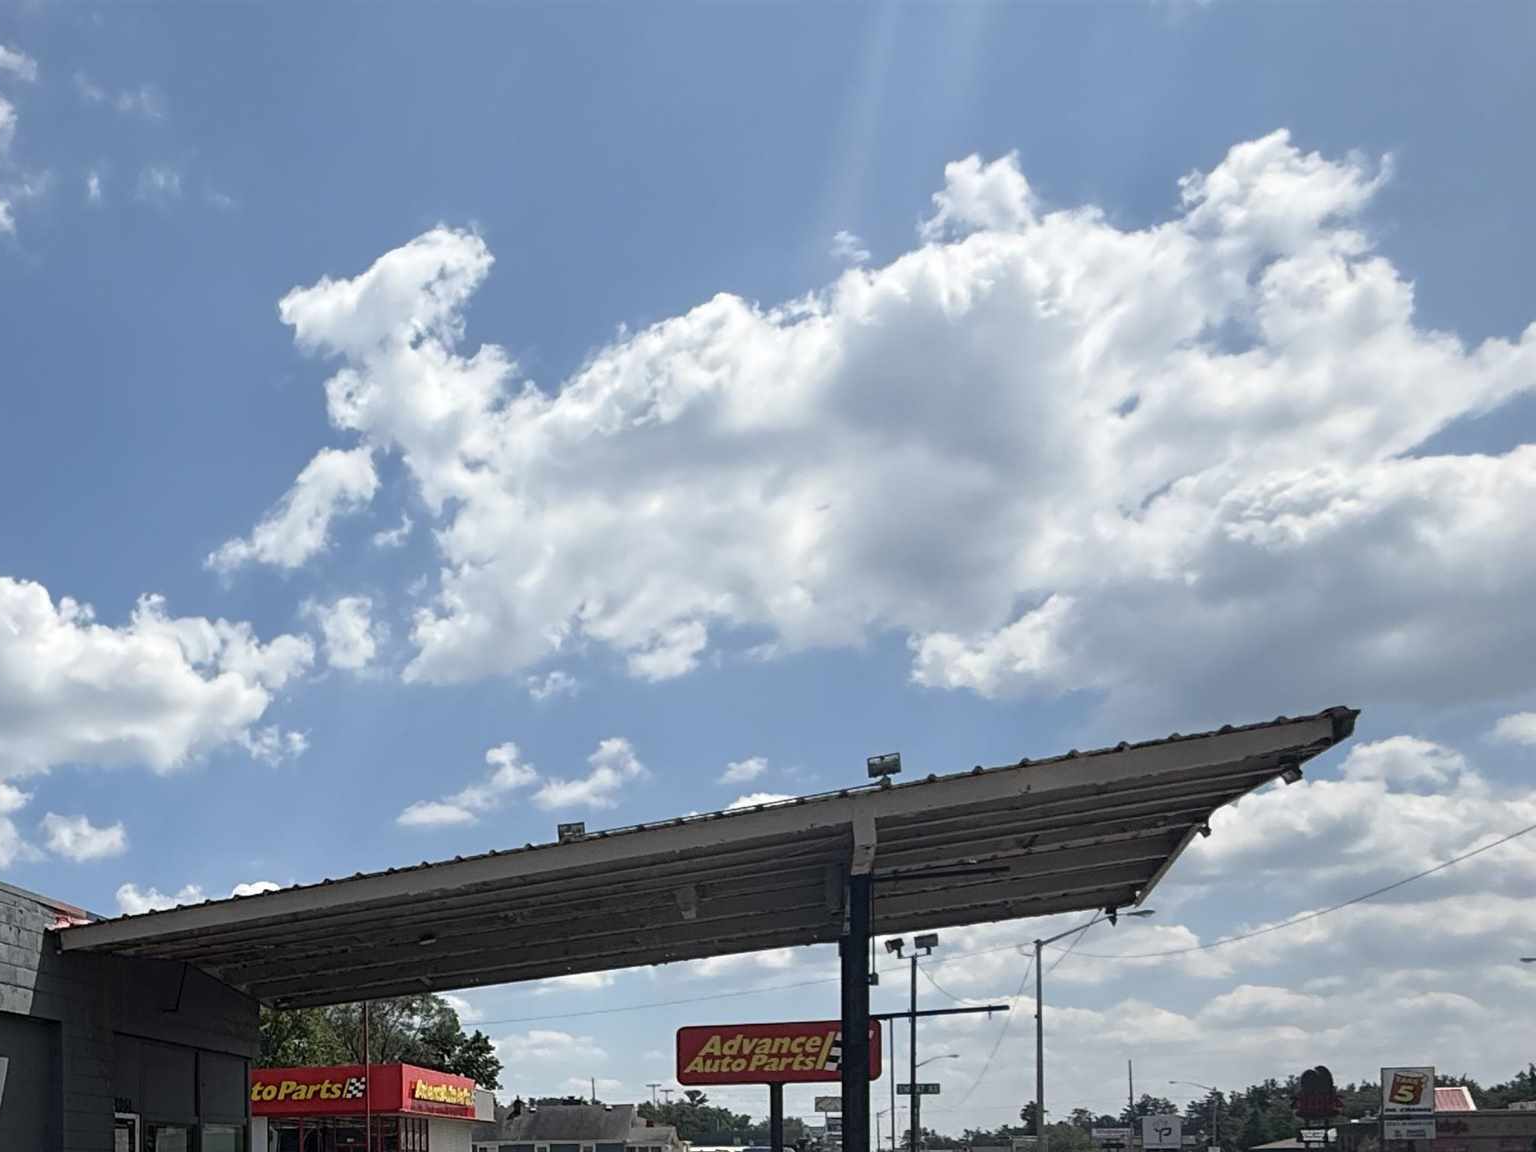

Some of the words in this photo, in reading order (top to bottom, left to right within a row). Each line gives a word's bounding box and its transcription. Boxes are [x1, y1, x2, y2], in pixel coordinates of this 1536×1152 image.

[697, 1034, 823, 1056] Advance
[684, 1056, 747, 1073] Auto
[747, 1053, 817, 1072] Parts
[277, 1080, 343, 1100] Parts
[1393, 1084, 1415, 1103] 5
